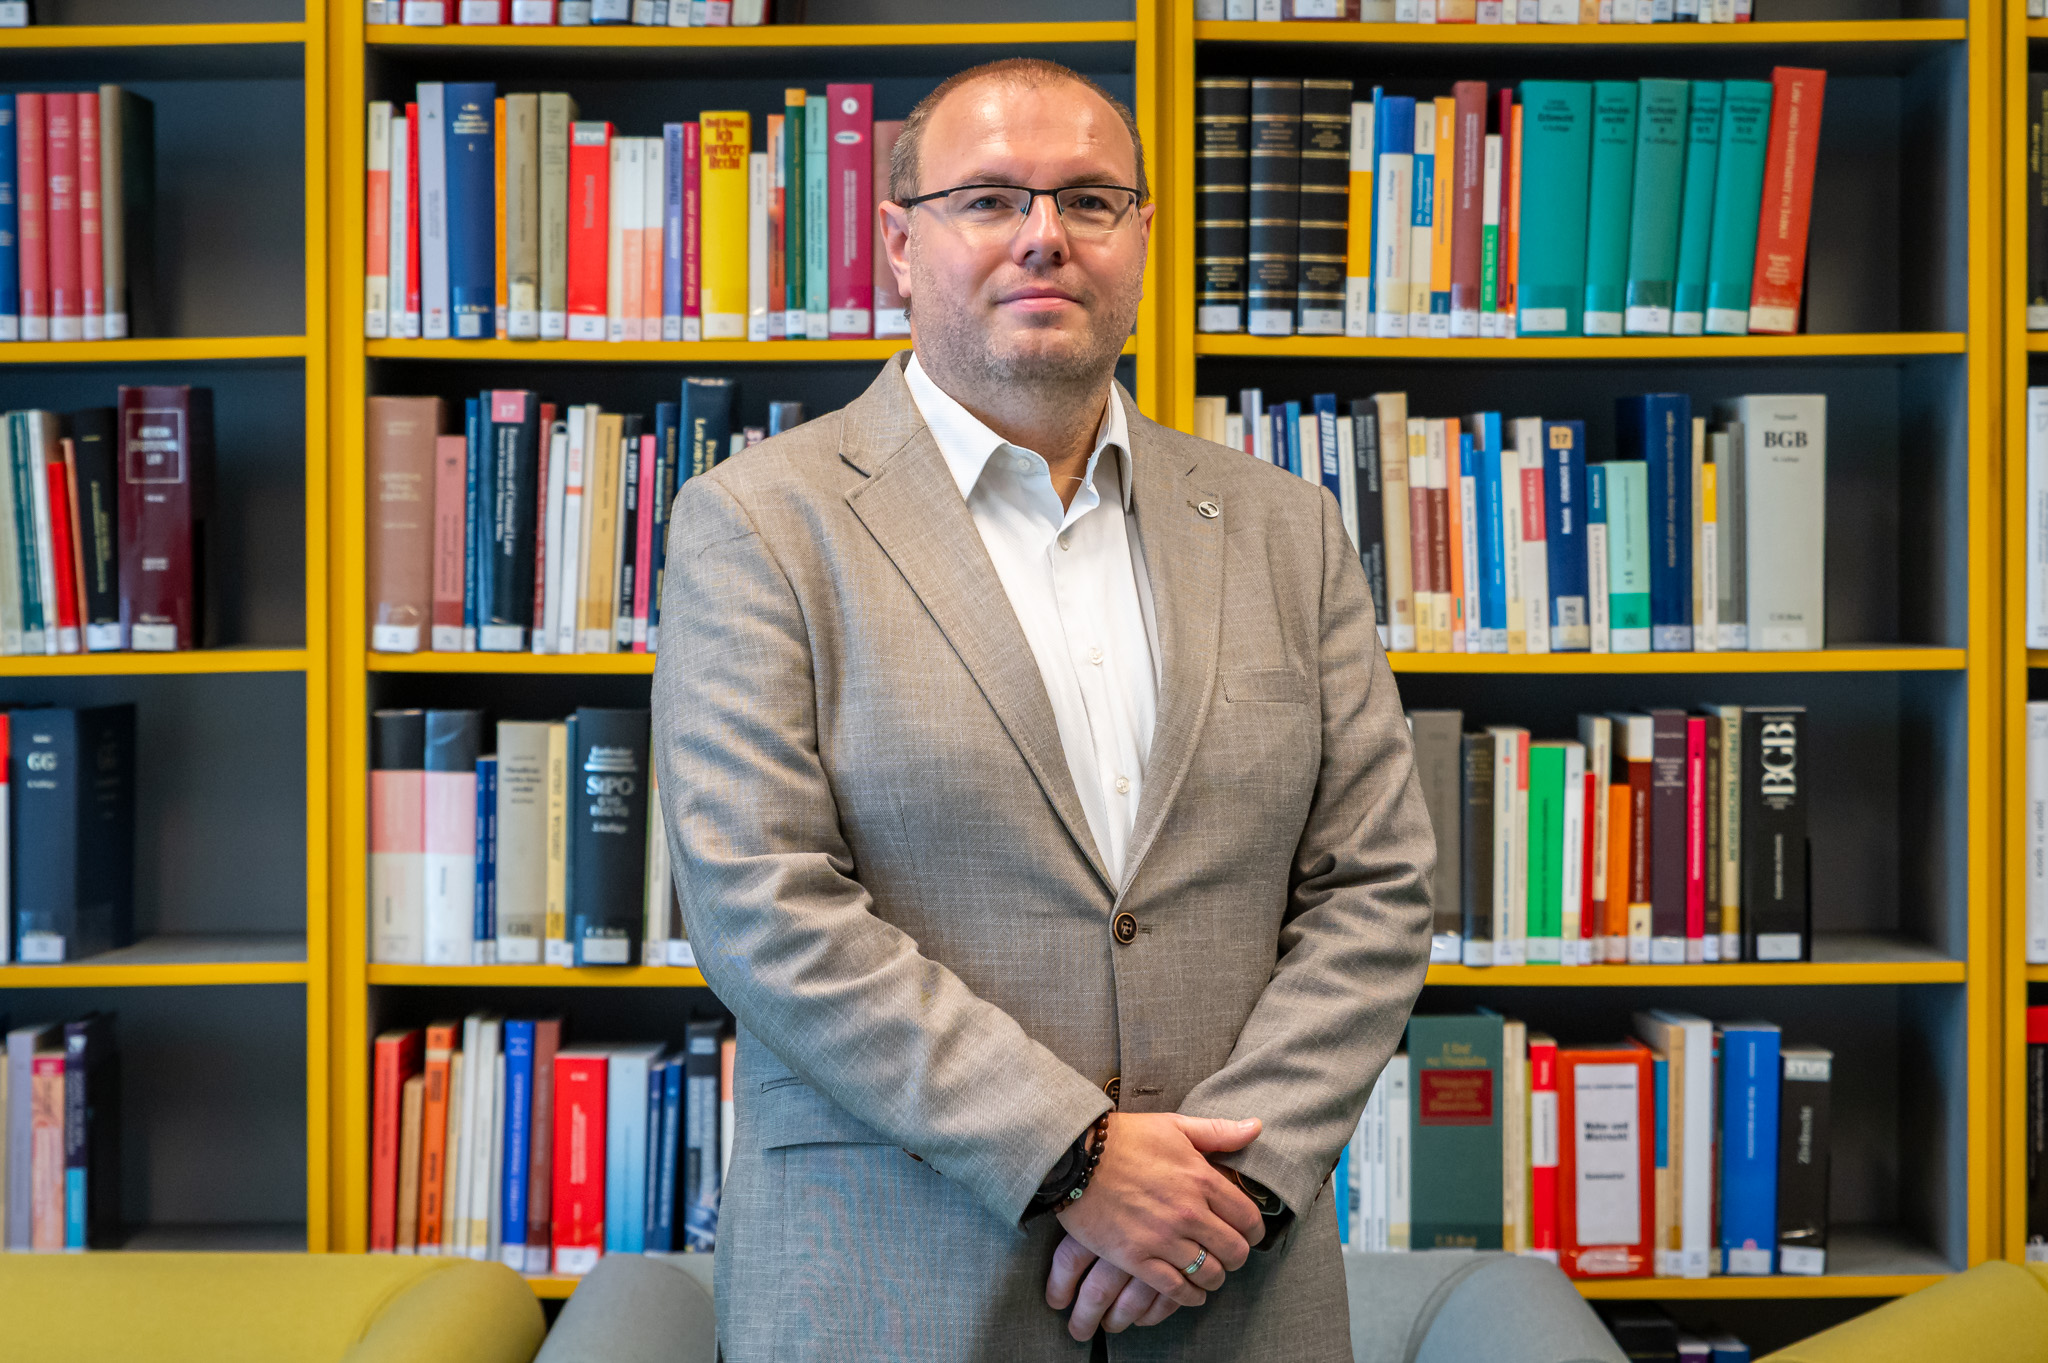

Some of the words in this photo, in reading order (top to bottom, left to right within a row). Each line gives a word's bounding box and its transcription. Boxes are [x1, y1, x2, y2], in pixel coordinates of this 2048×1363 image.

[1320, 410, 1337, 476] LUFTRECHT
[1554, 433, 1568, 445] 17
[1764, 430, 1809, 449] BGB
[1786, 1060, 1828, 1075] STUD
